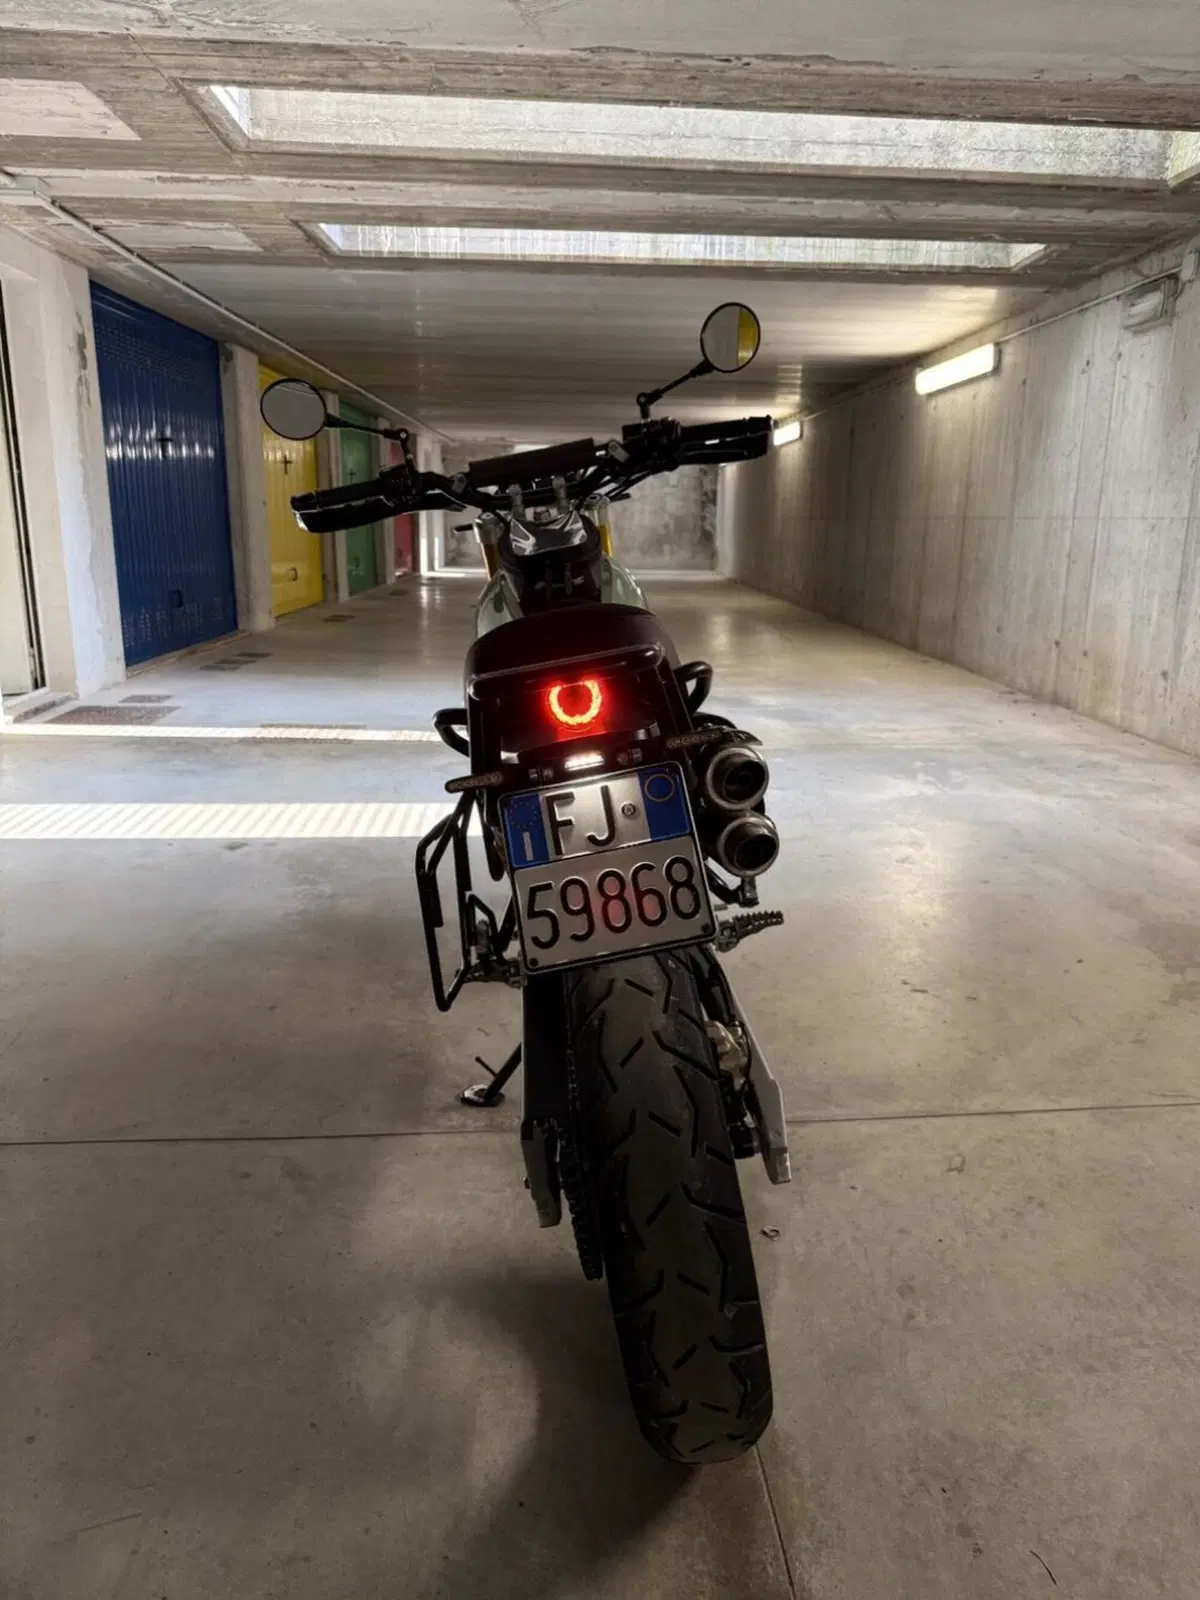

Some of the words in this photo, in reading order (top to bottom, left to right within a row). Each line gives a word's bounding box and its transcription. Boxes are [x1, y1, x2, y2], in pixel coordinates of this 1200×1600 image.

[522, 831, 534, 861] I
[545, 785, 616, 856] FJ
[526, 856, 701, 949] 59868
